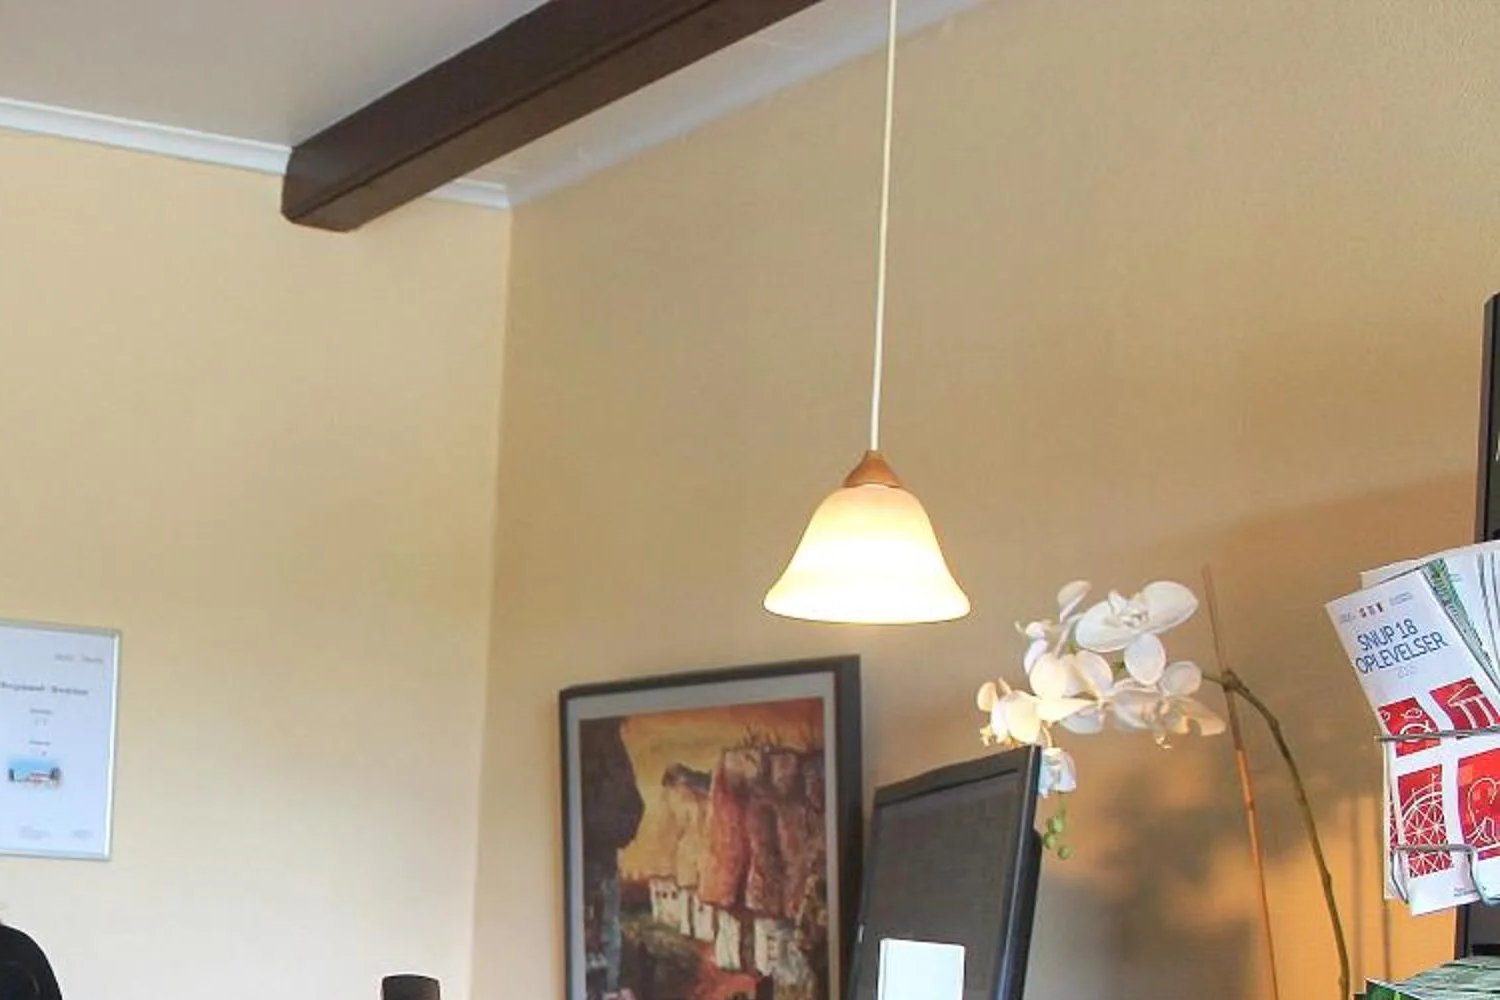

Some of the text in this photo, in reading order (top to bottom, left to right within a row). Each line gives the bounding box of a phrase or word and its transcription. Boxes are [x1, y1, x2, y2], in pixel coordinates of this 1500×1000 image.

[1355, 631, 1449, 674] OPLEVELSER
[1357, 618, 1418, 651] SNUP 18
